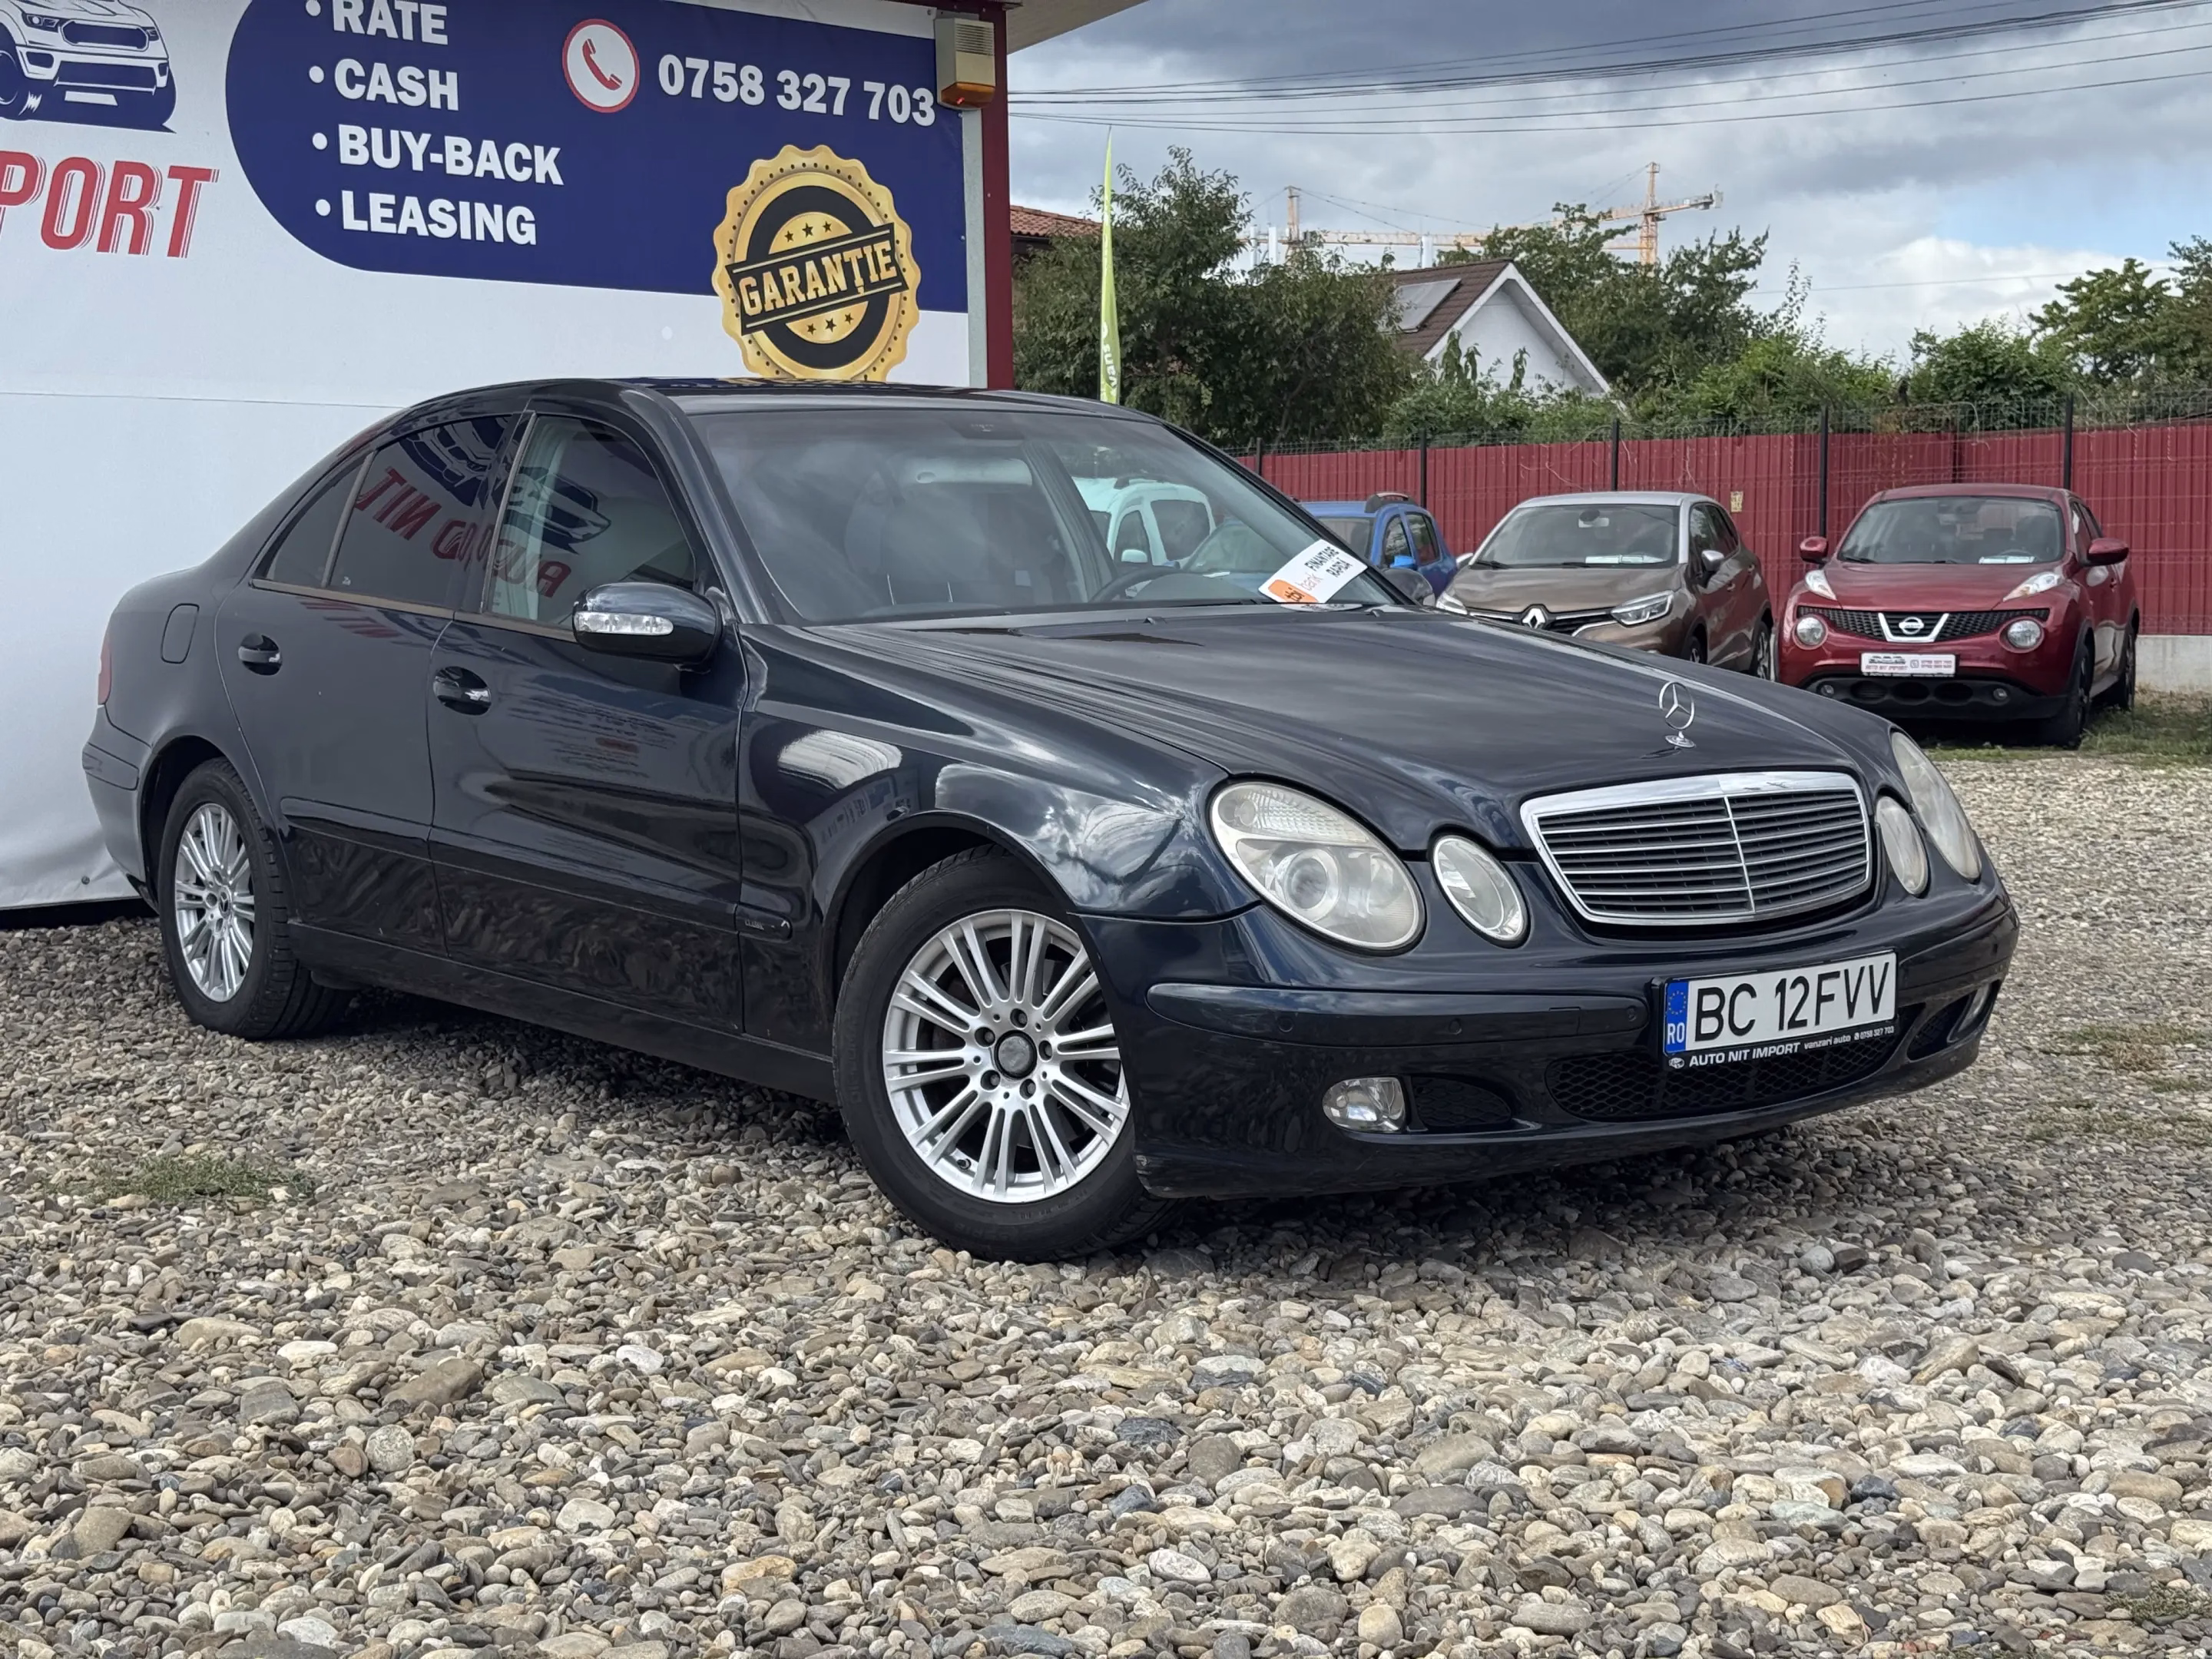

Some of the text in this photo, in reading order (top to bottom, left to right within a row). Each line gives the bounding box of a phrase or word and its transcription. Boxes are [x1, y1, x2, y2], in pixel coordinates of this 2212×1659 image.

[333, 0, 449, 45] RATE
[334, 58, 459, 111] CASH
[658, 55, 935, 127] 0758 327 703
[338, 124, 564, 186] BUY-BACK
[340, 190, 537, 246] LEASING
[1667, 1022, 1685, 1045] RO
[1694, 983, 1757, 1042] BC
[1689, 1052, 1725, 1067] AUTO
[1728, 1049, 1750, 1062] NIT
[1752, 1042, 1800, 1059] IMPORT
[1833, 1035, 1851, 1045] auto
